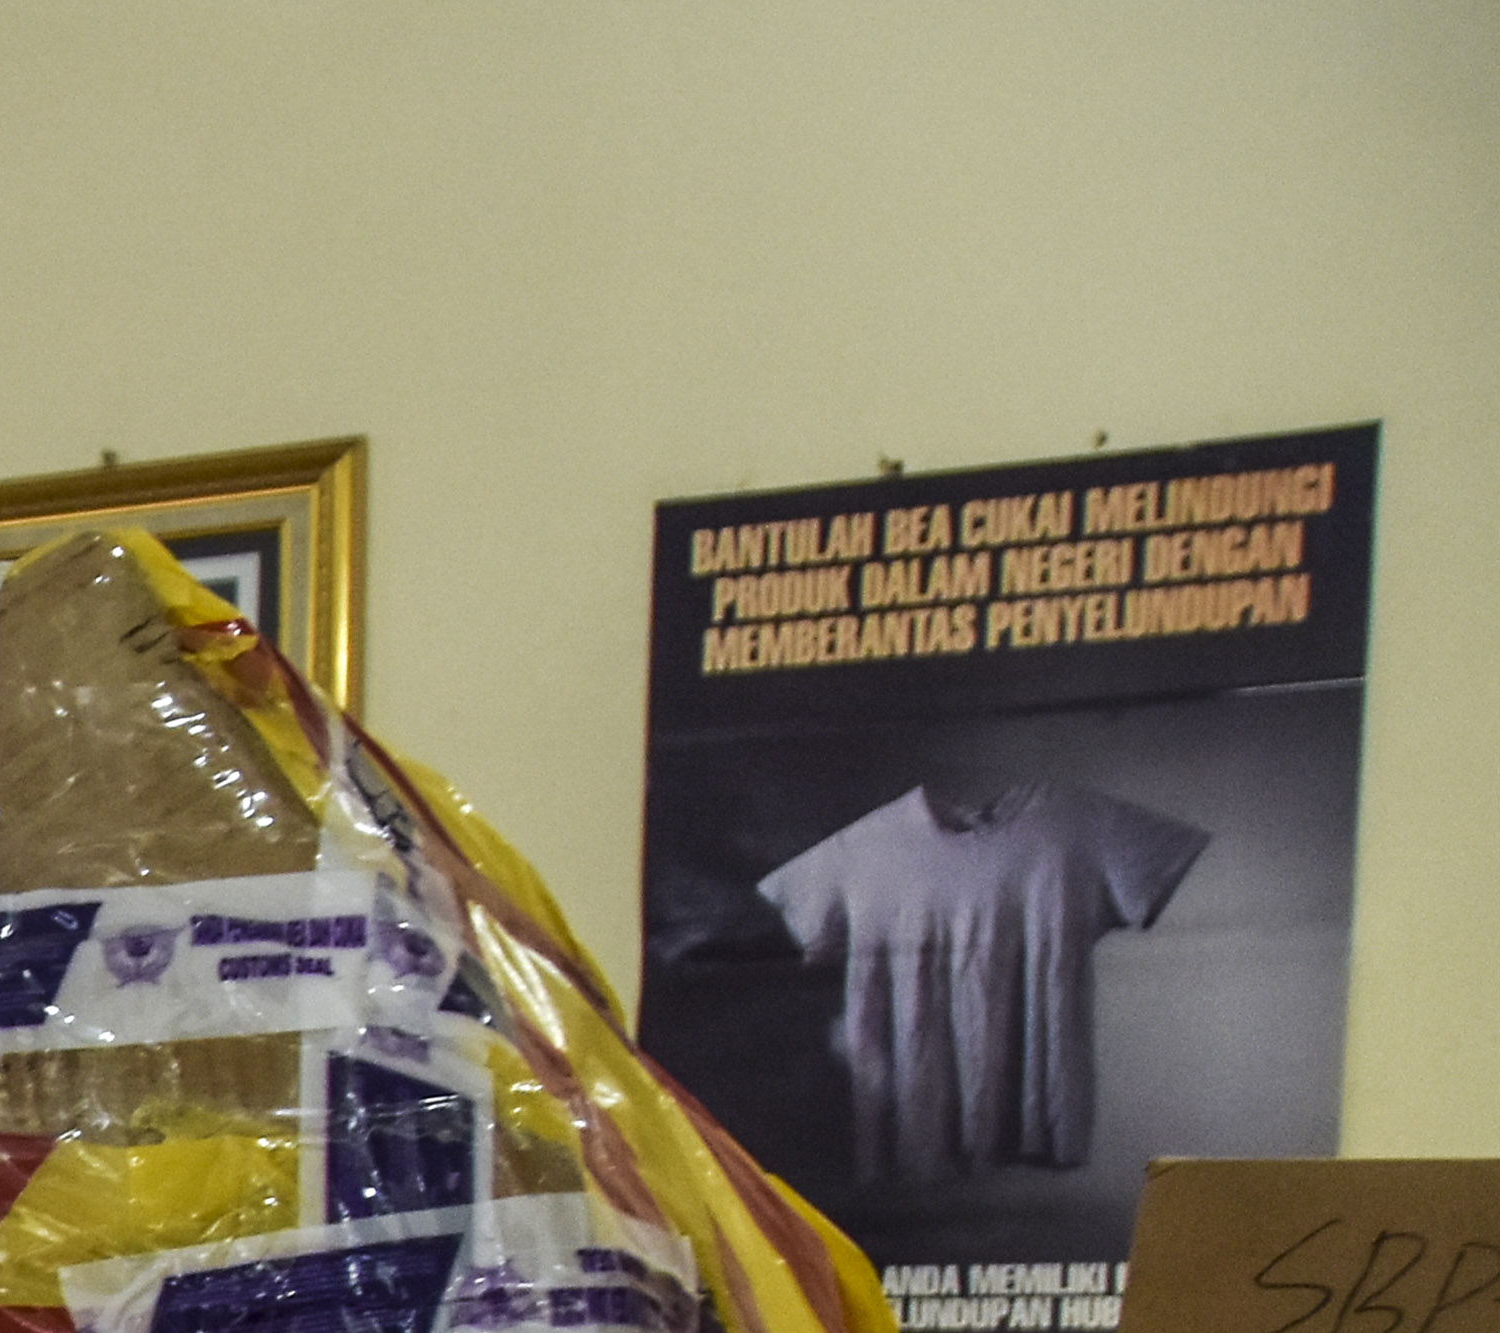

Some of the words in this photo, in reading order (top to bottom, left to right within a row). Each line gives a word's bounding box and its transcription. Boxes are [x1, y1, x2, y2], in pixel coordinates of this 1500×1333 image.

[691, 512, 877, 577] BANTULAH
[884, 503, 952, 556] BEA
[960, 490, 1075, 547] CUKAI
[1084, 462, 1335, 537] MELINDUNGI
[712, 563, 851, 622] PRODUK
[861, 549, 991, 609] DALAM
[1002, 536, 1134, 597] NEGERI
[1144, 520, 1304, 583] DENGAN
[702, 603, 976, 674] MEMBERANTAS
[985, 572, 1311, 650] PENYELUNDUPAN
[883, 1264, 960, 1296] ANDA
[969, 1262, 1108, 1294] MEMILIKI
